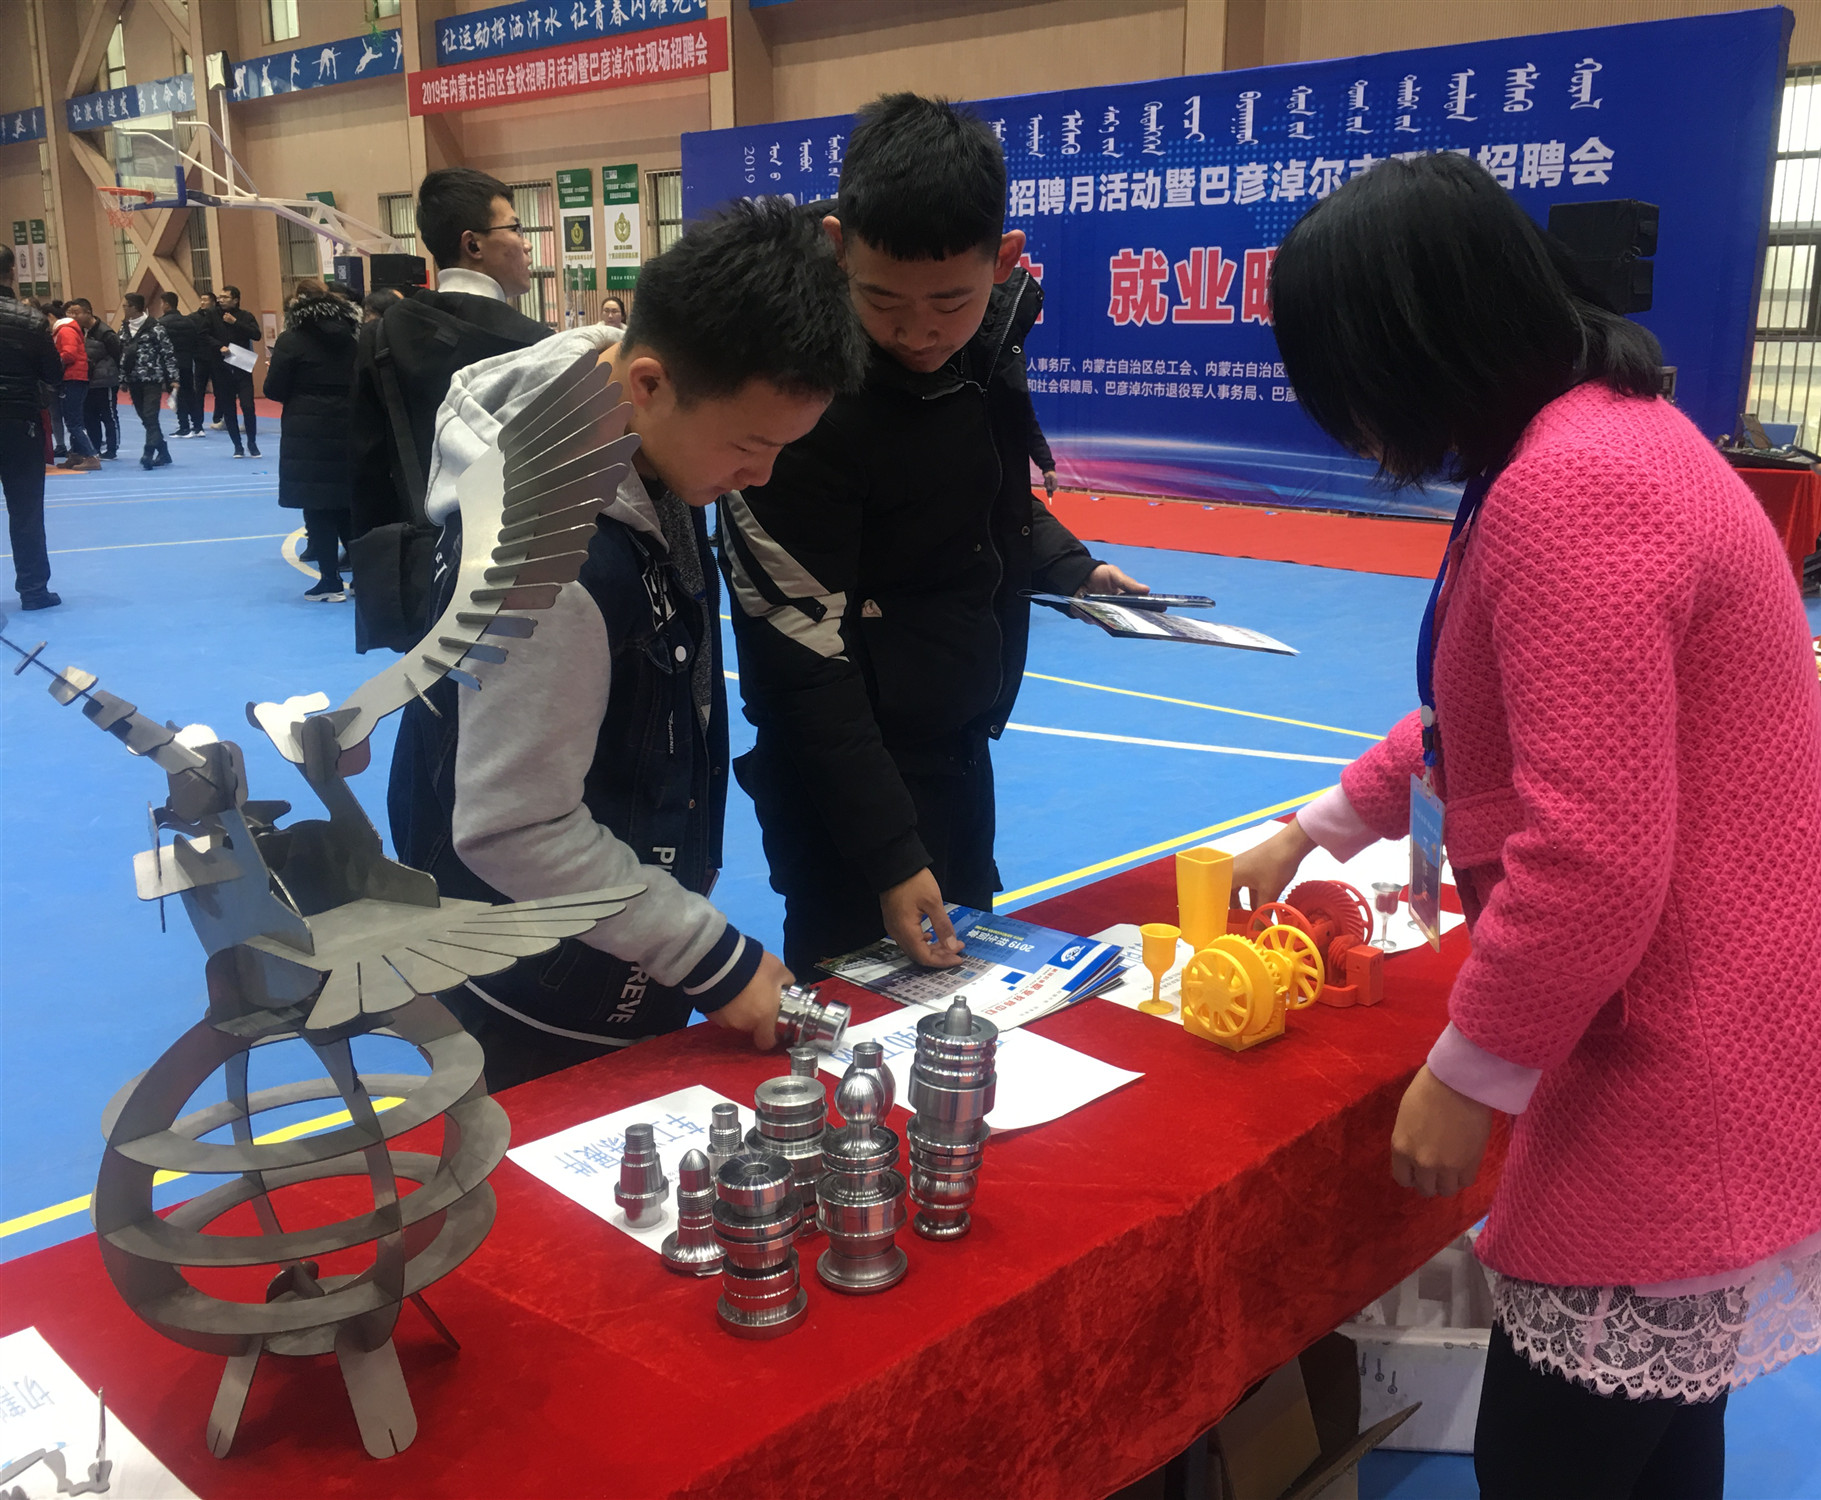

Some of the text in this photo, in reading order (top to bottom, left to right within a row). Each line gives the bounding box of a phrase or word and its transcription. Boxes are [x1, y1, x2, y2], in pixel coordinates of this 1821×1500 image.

[441, 14, 563, 55] 让运动挥洒汗水
[422, 32, 708, 105] 2019年内蒙古自治区金秋招聘月活动暨巴彦淖尔市现场招聘会
[744, 145, 756, 184] 2019
[1010, 135, 1615, 218] 招聘月活动暨巴彦淖尔招聘会
